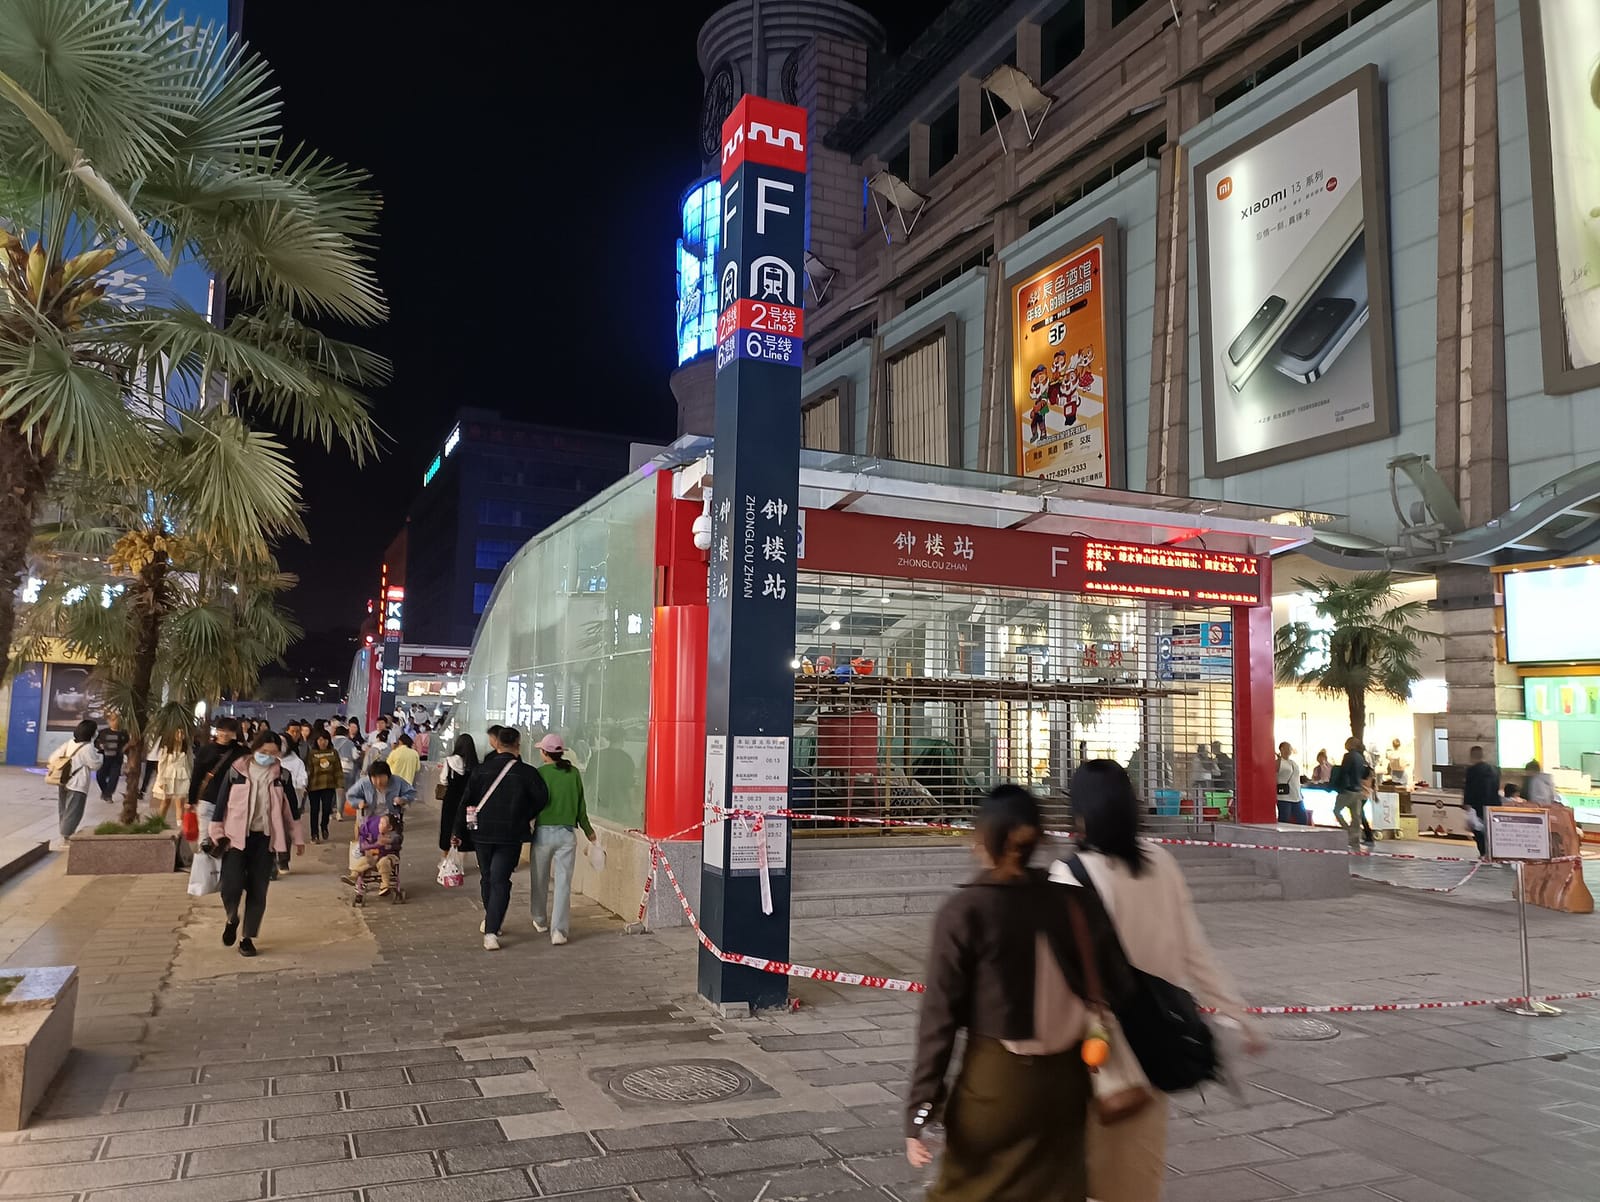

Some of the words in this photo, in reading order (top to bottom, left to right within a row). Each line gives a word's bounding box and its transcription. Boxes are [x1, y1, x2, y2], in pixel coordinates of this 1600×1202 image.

[757, 177, 794, 235] F
[1241, 188, 1287, 220] xiaomi
[1291, 181, 1301, 193] 13
[1306, 169, 1323, 187] 系列
[724, 180, 739, 249] F
[751, 304, 797, 329] 2号线
[767, 320, 787, 332] Line
[788, 324, 794, 332] 2
[746, 332, 793, 358] 6号线
[1049, 323, 1065, 344] 3F
[763, 349, 783, 360] Line
[783, 353, 790, 361] 6
[744, 494, 756, 563] ZHONGLOU
[760, 498, 788, 600] 钟楼站
[893, 530, 975, 561] 钟楼站
[897, 557, 945, 571] ZHONGLOU
[945, 561, 969, 572] ZHAN
[1051, 546, 1069, 578] F
[743, 565, 754, 598] ZHAN
[388, 602, 402, 617] K
